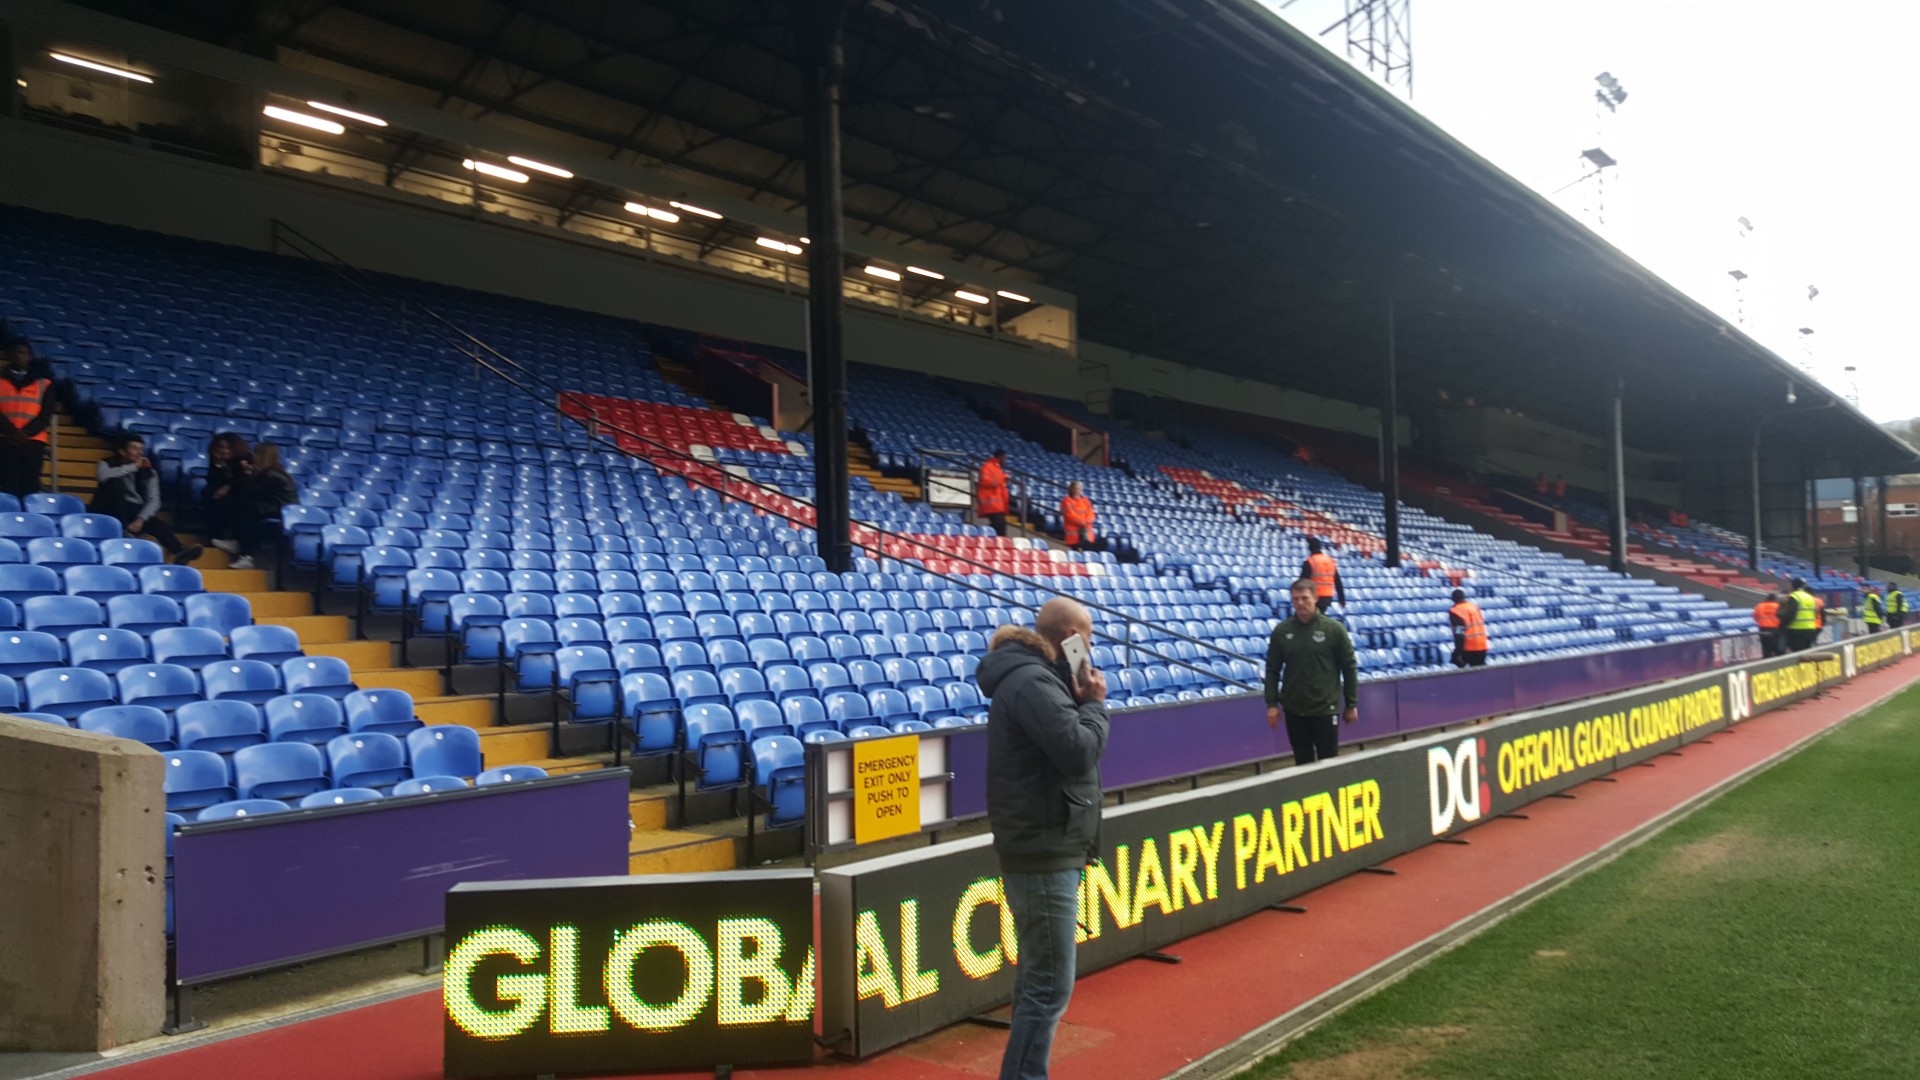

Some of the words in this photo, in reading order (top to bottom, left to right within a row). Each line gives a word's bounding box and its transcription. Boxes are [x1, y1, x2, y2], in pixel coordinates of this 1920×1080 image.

[1498, 726, 1574, 794] OFFICIAL
[1573, 712, 1631, 767] GLOBAL
[1629, 696, 1684, 749] CULINARY
[1682, 685, 1724, 731] PARTNER
[858, 756, 916, 772] EMERGENCY
[864, 776, 884, 788] EXIT
[888, 771, 911, 784] ONLY
[868, 789, 893, 804] PUSH
[897, 786, 909, 798] TO
[877, 804, 902, 818] OPEN
[952, 821, 1225, 981] CINARY
[1233, 778, 1384, 890] PARTNER
